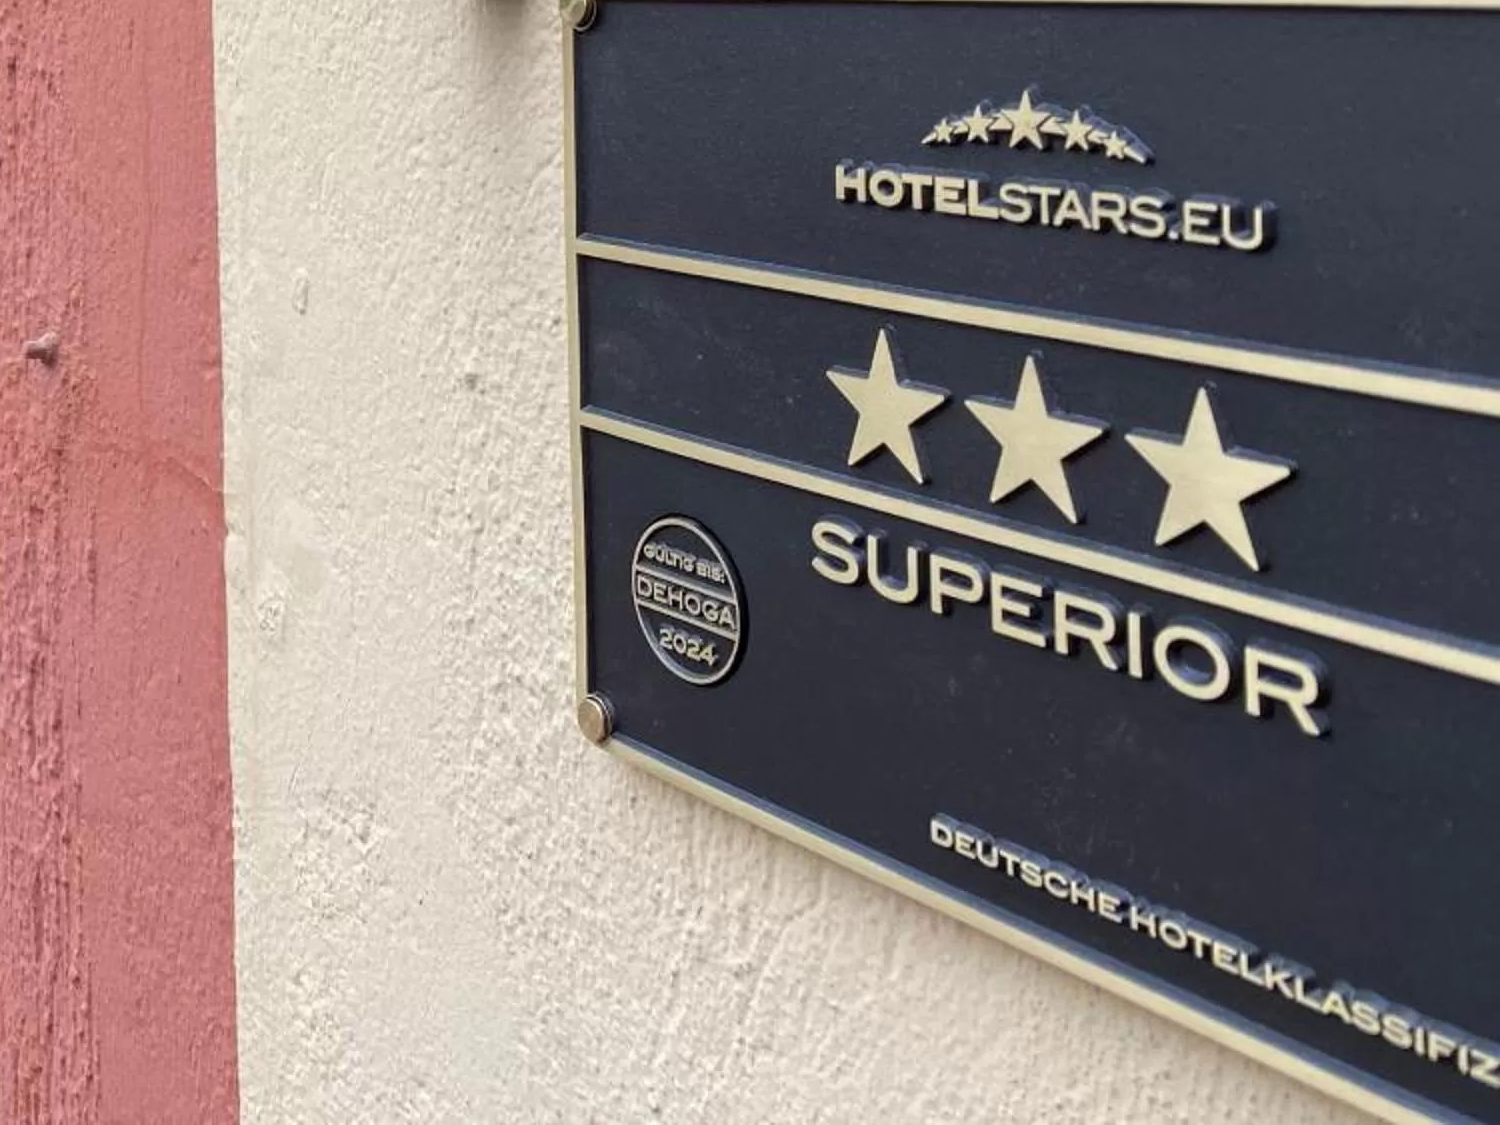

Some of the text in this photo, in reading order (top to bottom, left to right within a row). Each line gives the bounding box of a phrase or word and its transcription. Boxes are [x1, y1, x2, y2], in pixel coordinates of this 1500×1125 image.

[834, 162, 1266, 252] HOTELSTARS.EU
[636, 575, 735, 629] DEHOGA
[659, 626, 718, 667] 2024
[810, 518, 1332, 739] SUPERIOR
[930, 817, 1124, 923] DEUTSCHE
